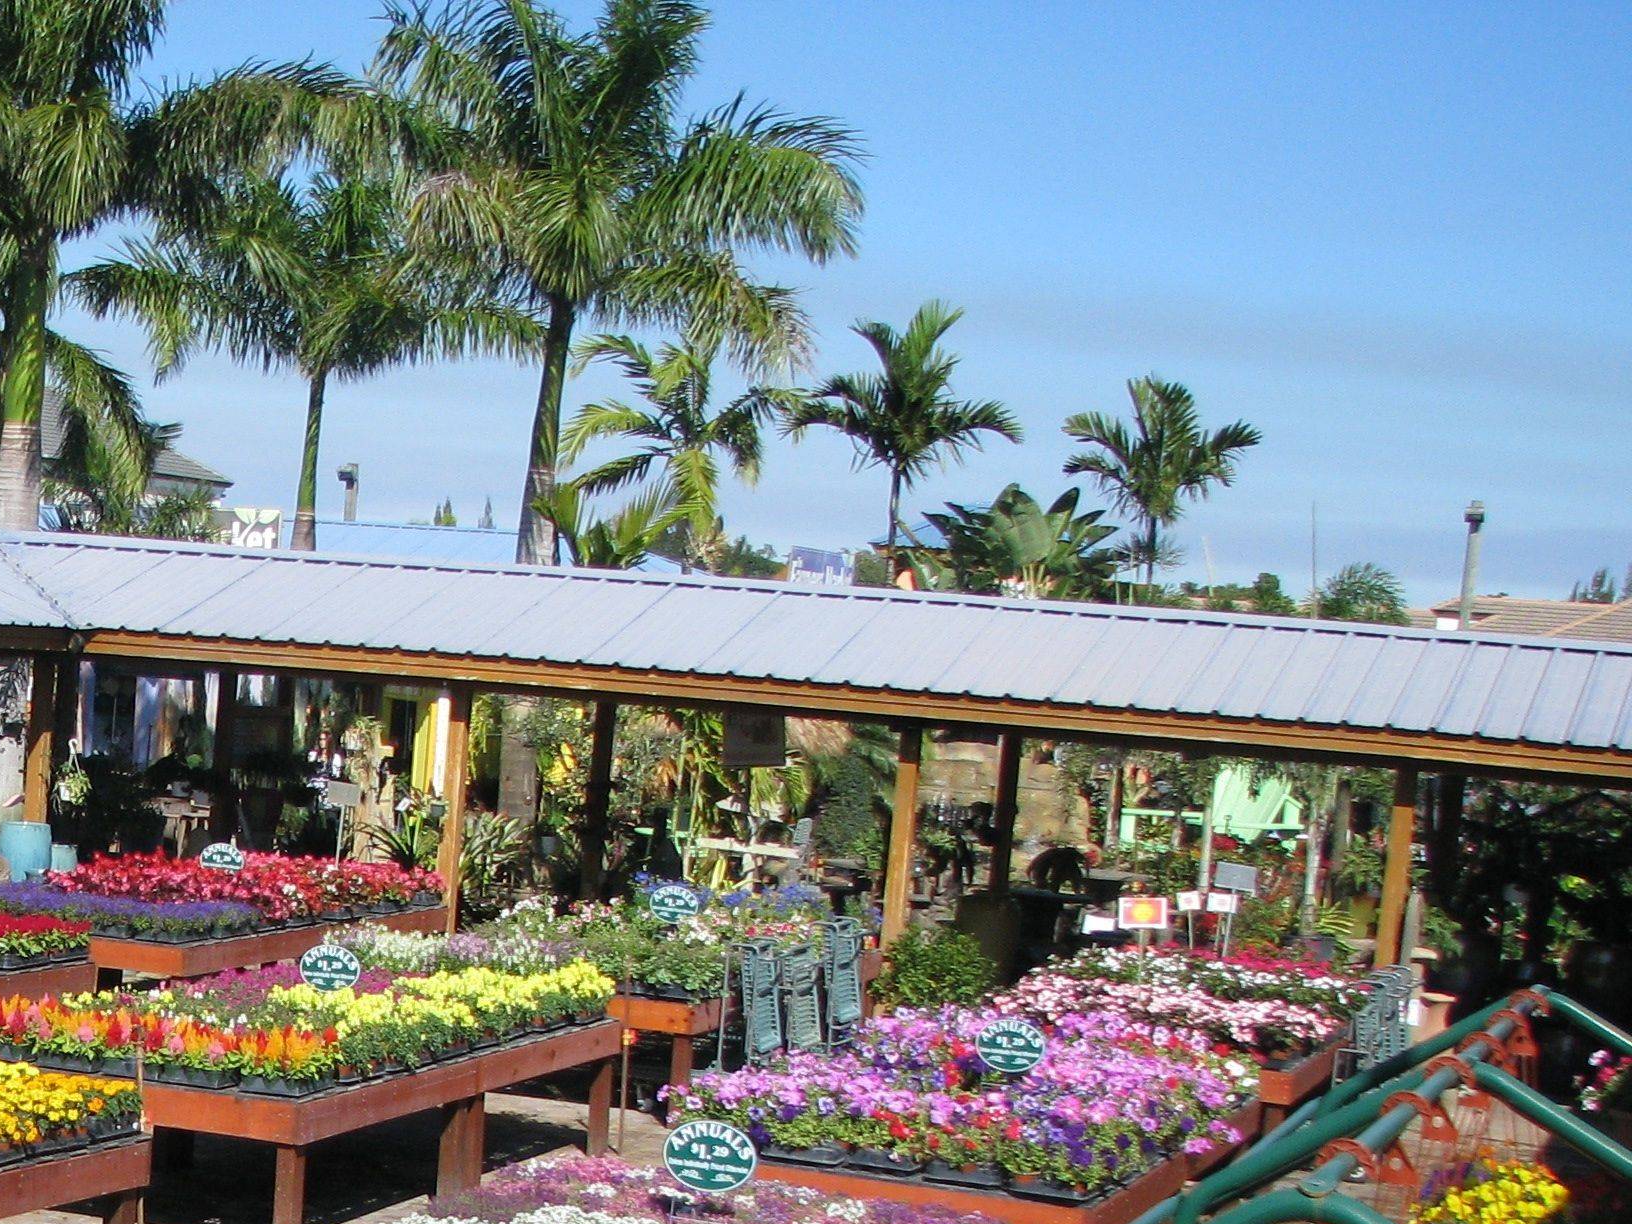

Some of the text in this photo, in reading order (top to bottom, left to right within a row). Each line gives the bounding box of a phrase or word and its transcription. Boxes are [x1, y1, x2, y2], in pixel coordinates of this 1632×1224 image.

[304, 947, 357, 970] ANNUALS
[981, 1021, 1043, 1048] ANNUALS
[671, 1123, 752, 1160] ANNUALS
